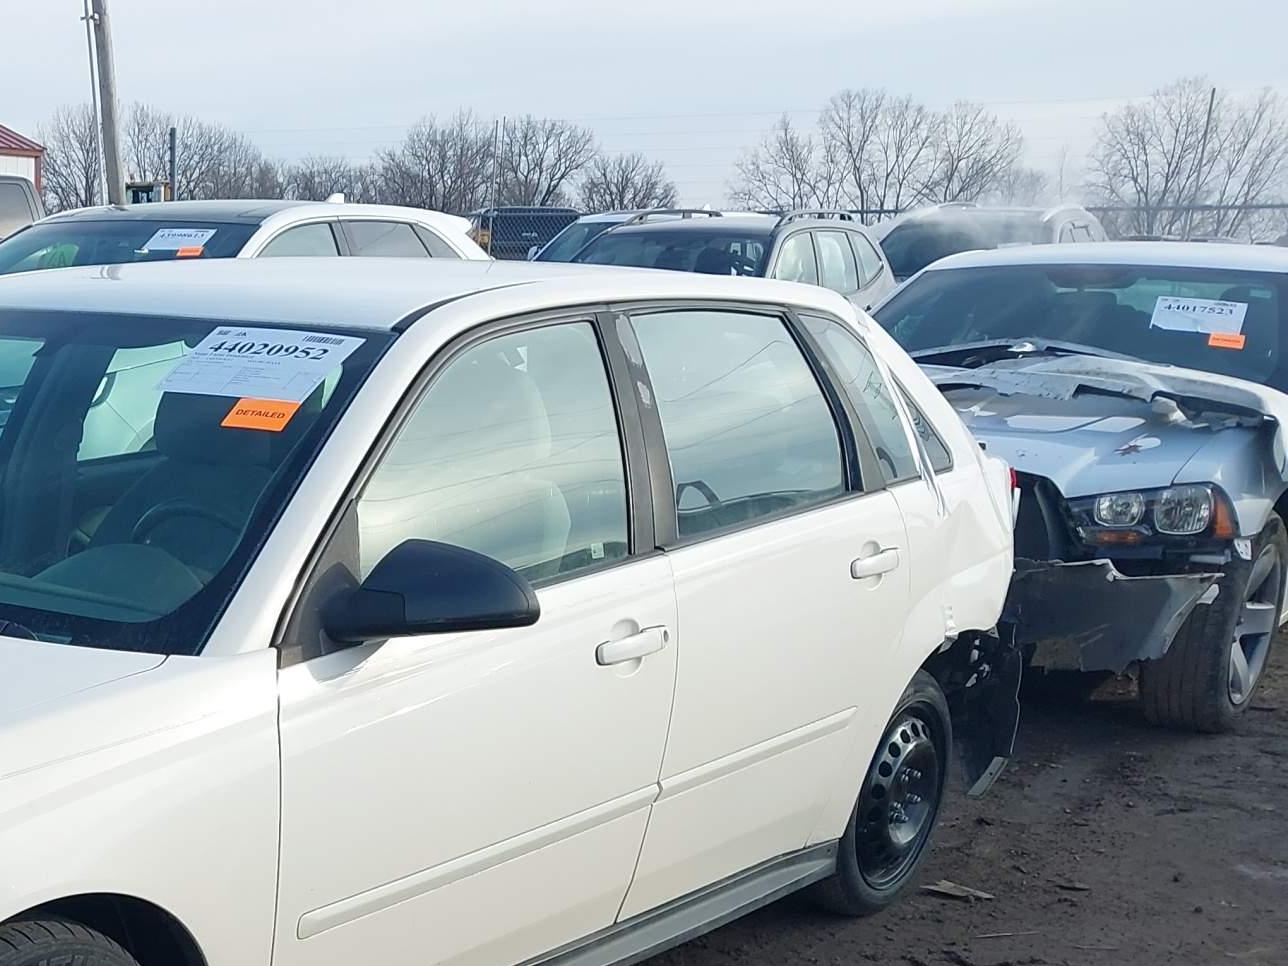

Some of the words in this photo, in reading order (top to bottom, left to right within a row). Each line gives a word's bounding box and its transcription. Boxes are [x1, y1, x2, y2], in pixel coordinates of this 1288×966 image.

[1163, 303, 1234, 316] 44017523
[208, 340, 330, 361] 44020952
[235, 408, 286, 420] DETAILED
